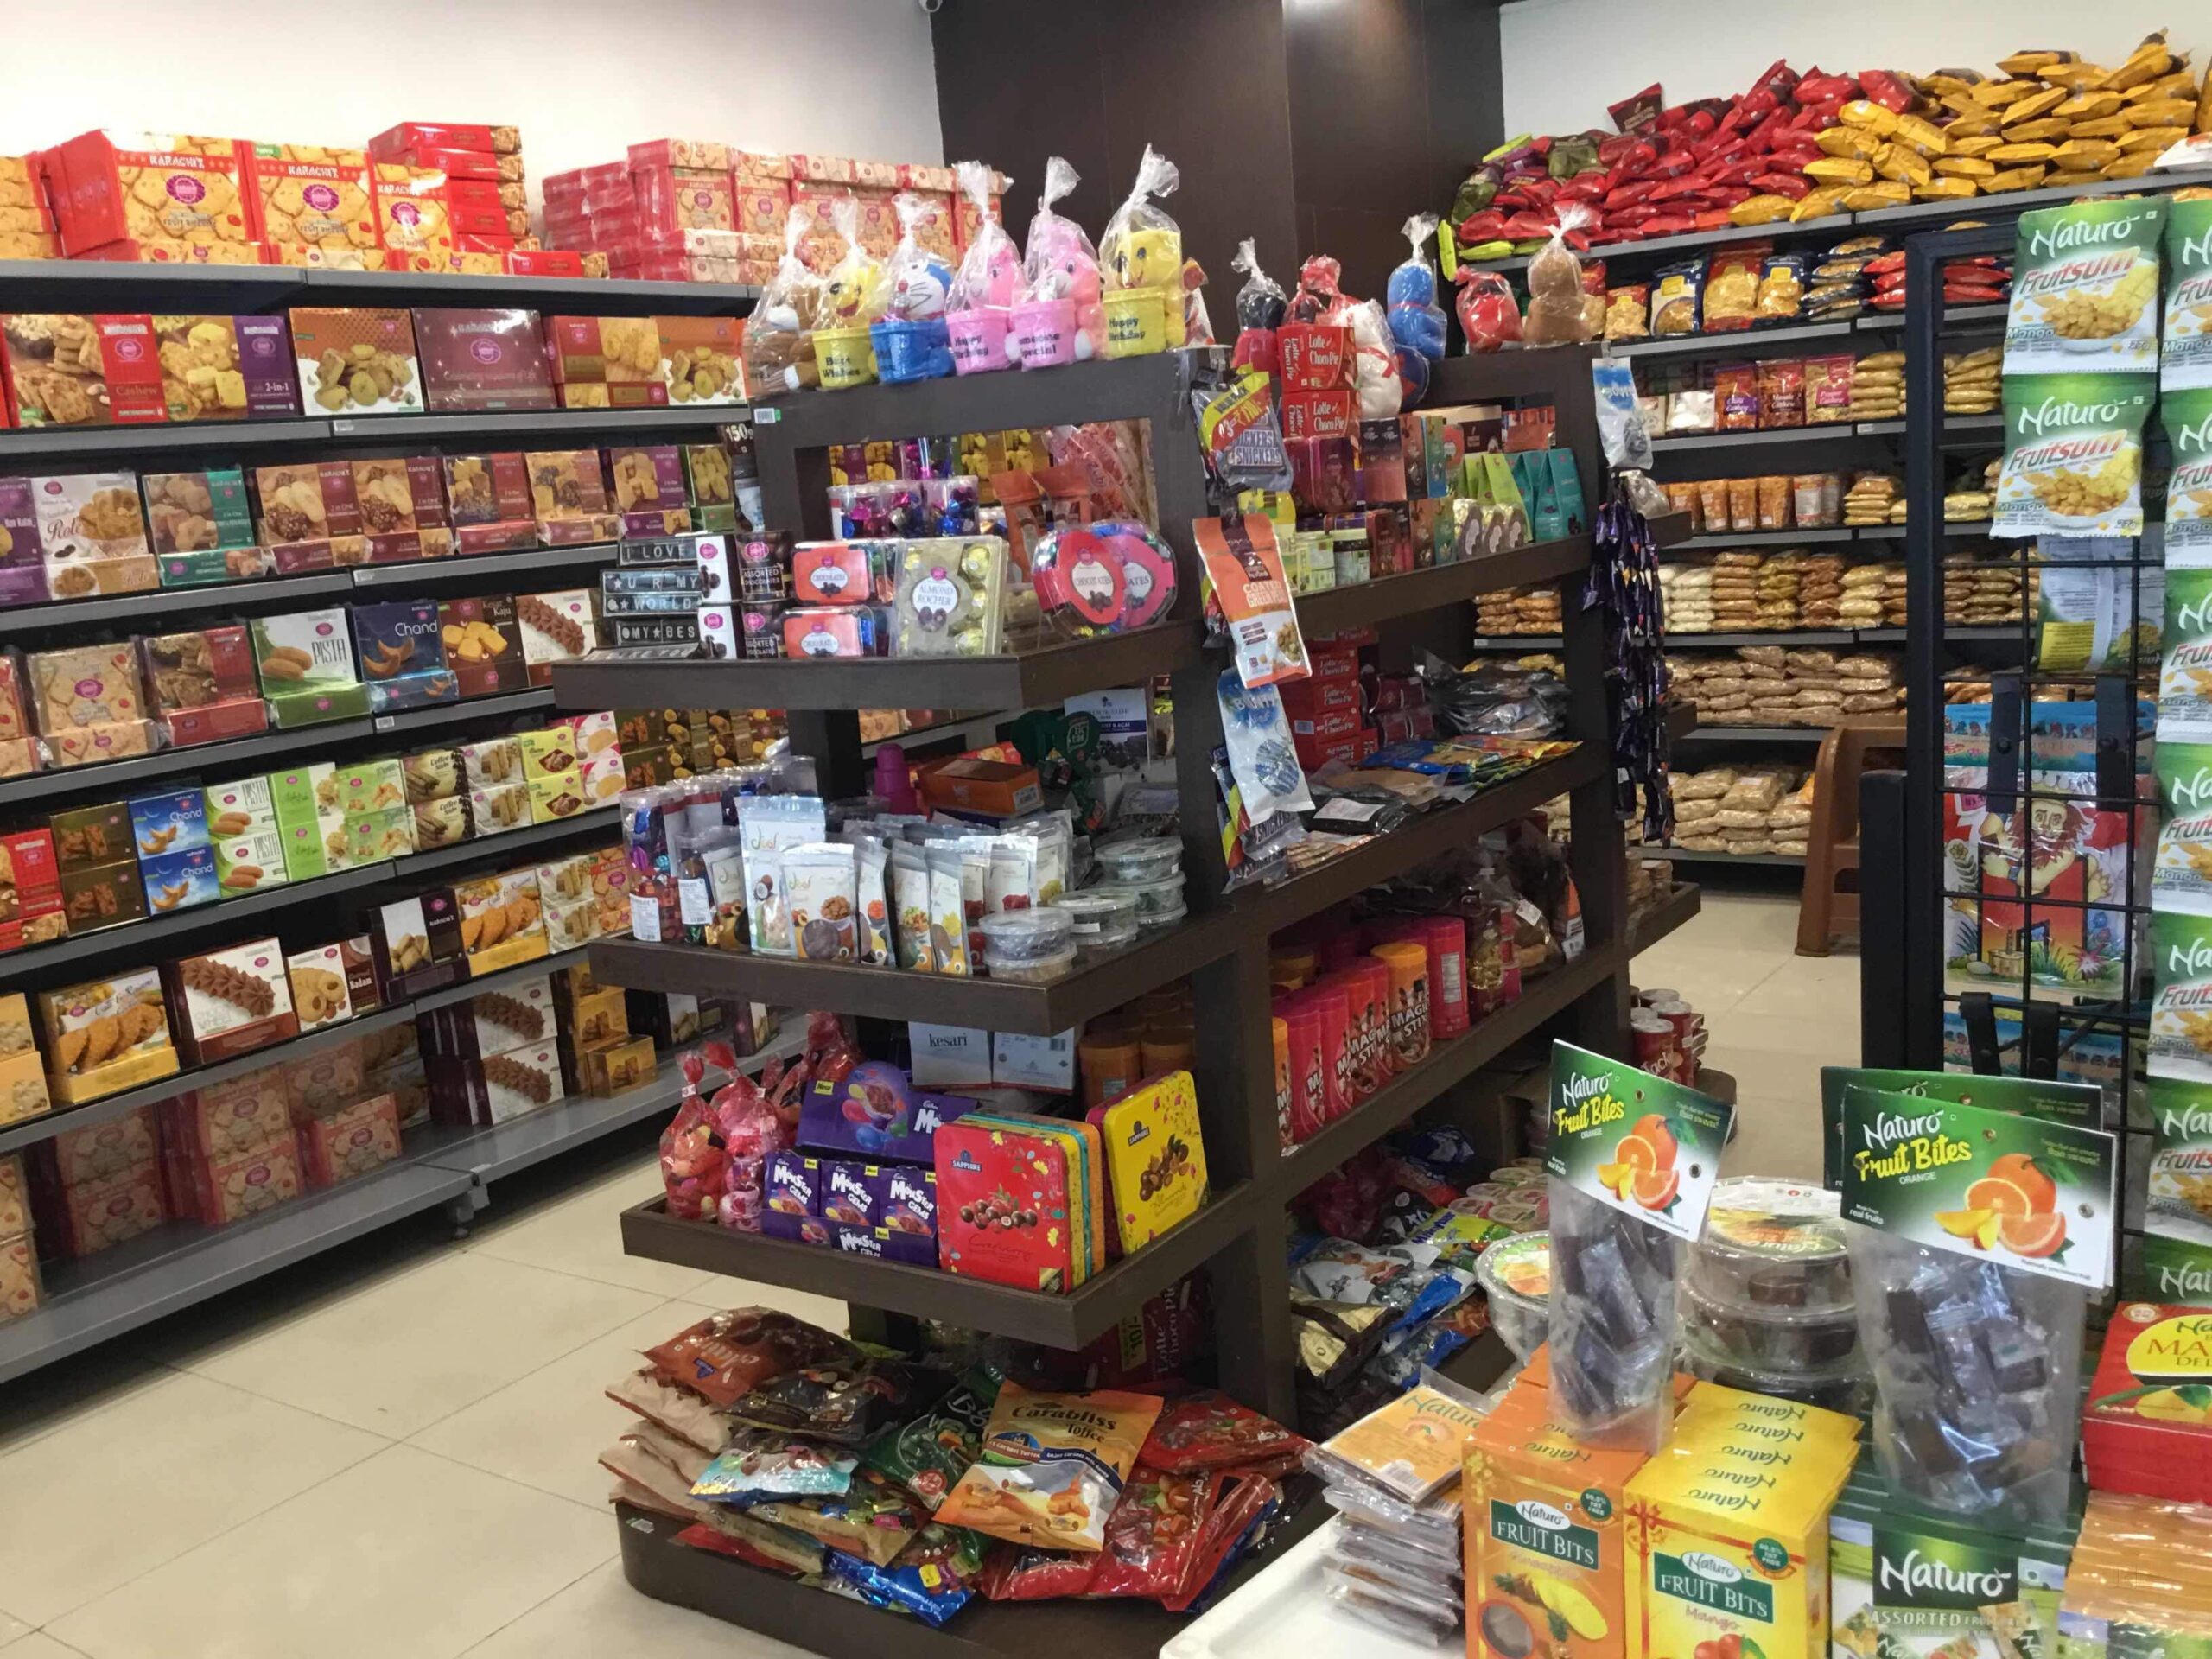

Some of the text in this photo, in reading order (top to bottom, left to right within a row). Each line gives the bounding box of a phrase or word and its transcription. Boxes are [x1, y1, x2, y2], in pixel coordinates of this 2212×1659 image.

[2031, 214, 2141, 259] Naturo
[2019, 251, 2138, 295] Fruitsum
[1309, 334, 1325, 349] Lotte
[2006, 327, 2055, 340] Mango
[1313, 400, 1331, 416] Lotte
[2018, 396, 2128, 436] Naturo
[1235, 447, 1281, 466] SNICKERS
[2008, 430, 2127, 471] Fruitsum
[1998, 501, 2045, 513] Mango
[642, 544, 685, 559] LOVE
[627, 576, 697, 589] U R MY
[743, 569, 779, 578] ASSORTED
[918, 584, 954, 594] ALMOND
[1243, 580, 1282, 594] COATED
[633, 598, 692, 611] WORLD
[917, 594, 951, 606] ROCHER
[394, 620, 438, 638] Chand
[632, 624, 696, 639] MY BES
[311, 637, 348, 665] PISTA
[745, 639, 775, 649] SSORTED
[430, 754, 452, 767] Coffee
[169, 807, 202, 822] Chand
[439, 799, 459, 812] Coffee
[2166, 816, 2212, 839] Fruit
[181, 862, 213, 879] Chand
[2154, 867, 2202, 881] Mango
[349, 976, 372, 990] Badam
[2160, 984, 2212, 1006] Fruit
[928, 1031, 969, 1048] kesari
[1349, 1027, 1376, 1055] MAG
[1562, 1071, 1613, 1108] Naturo
[1555, 1093, 1625, 1136] Fruit Bites
[1128, 1126, 1150, 1146] SAPPHIRE
[1863, 1109, 1944, 1150] Naturo
[952, 1160, 982, 1173] SAPPHIRE
[1857, 1137, 1973, 1182] Fruit Bites
[2158, 1148, 2212, 1168] Fruits
[1899, 1171, 1936, 1185] ORANGE
[789, 1185, 809, 1205] GEMS
[847, 1192, 868, 1213] GEMS
[907, 1200, 931, 1221] GEMS
[1156, 1325, 1169, 1374] Lotte
[1011, 1404, 1118, 1432] Carabliss
[1065, 1421, 1106, 1444] Toffee
[1521, 1503, 1565, 1529] Naturo
[1497, 1521, 1595, 1566] FRUIT BITS
[1689, 1554, 1736, 1580] Naturo
[1879, 1549, 2012, 1598] Naturo
[1661, 1573, 1768, 1618] FRUIT BITS
[1685, 1605, 1741, 1632] Mango
[1872, 1610, 1962, 1627] ASSORTED
